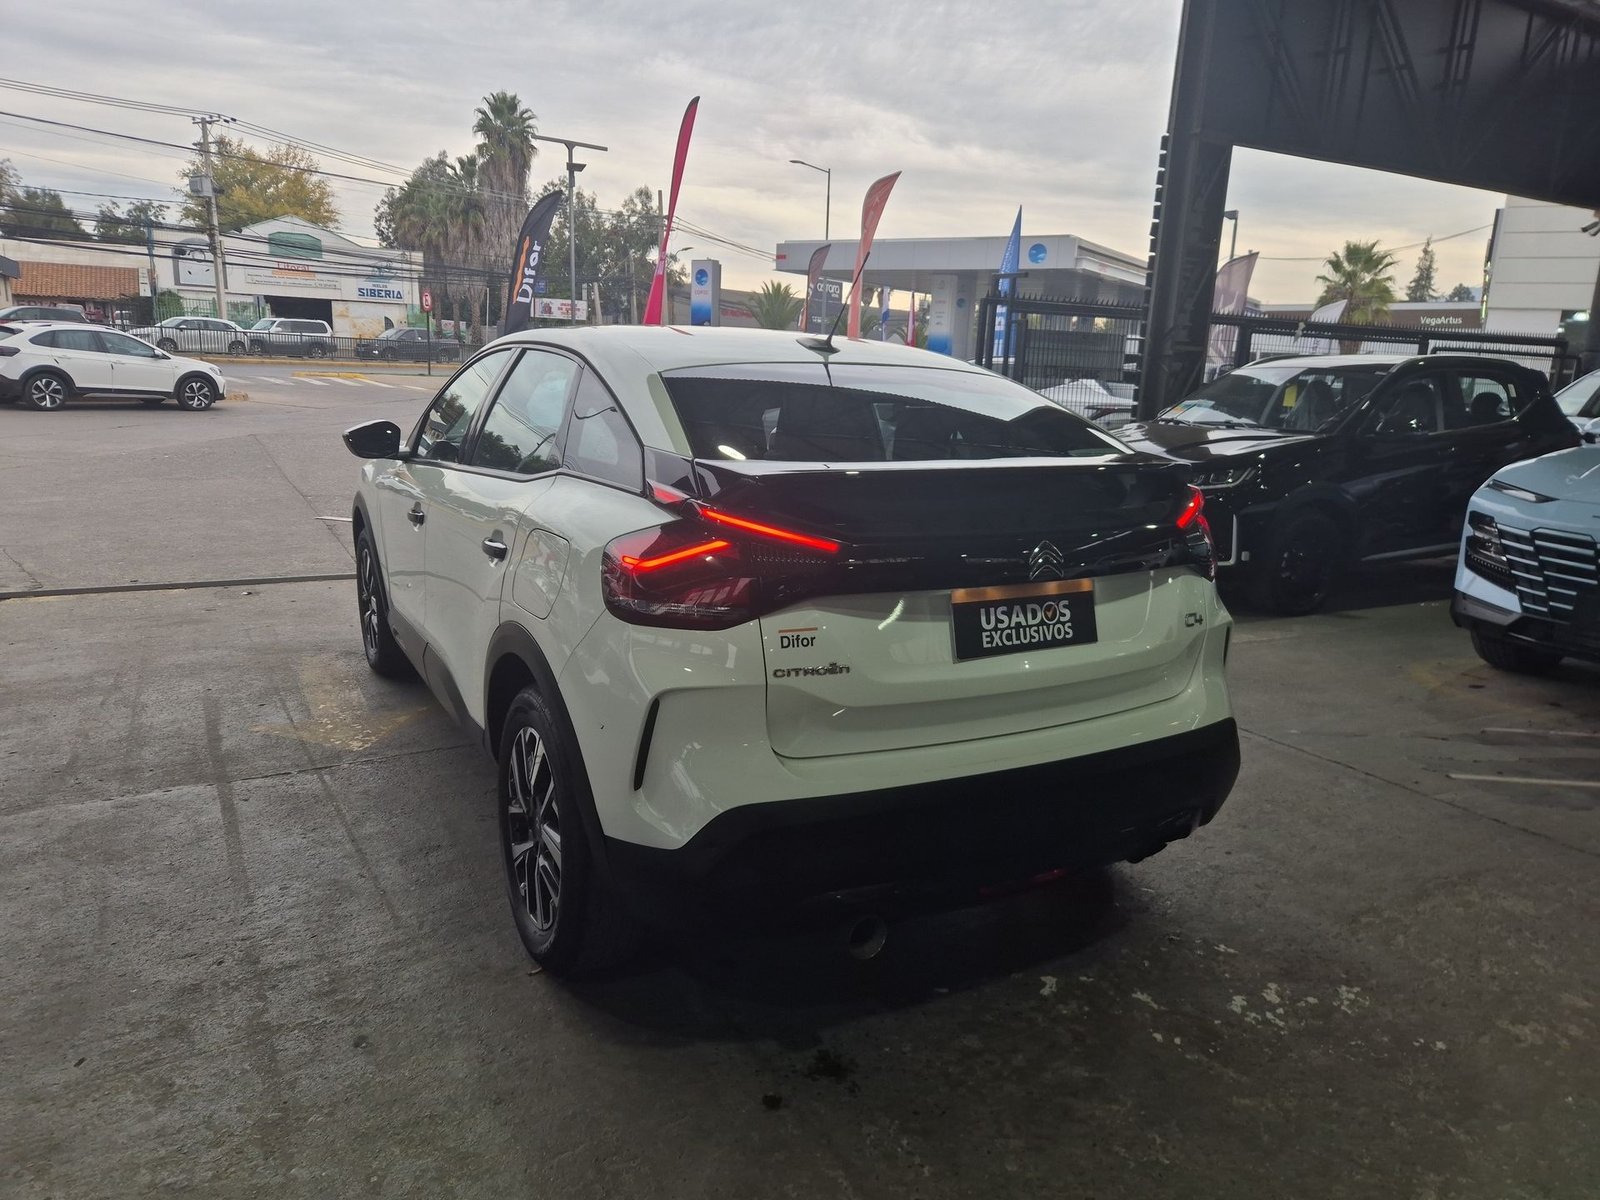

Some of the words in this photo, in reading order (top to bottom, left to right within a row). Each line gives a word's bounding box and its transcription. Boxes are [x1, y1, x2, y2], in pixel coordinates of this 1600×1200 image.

[516, 240, 542, 304] Difor
[358, 287, 403, 299] SIBERIA
[1420, 316, 1464, 326] VegaArtus
[980, 600, 1071, 630] USADOS
[1185, 612, 1204, 628] C4
[780, 634, 816, 649] Difor
[982, 622, 1073, 648] EXCLUSIVOS
